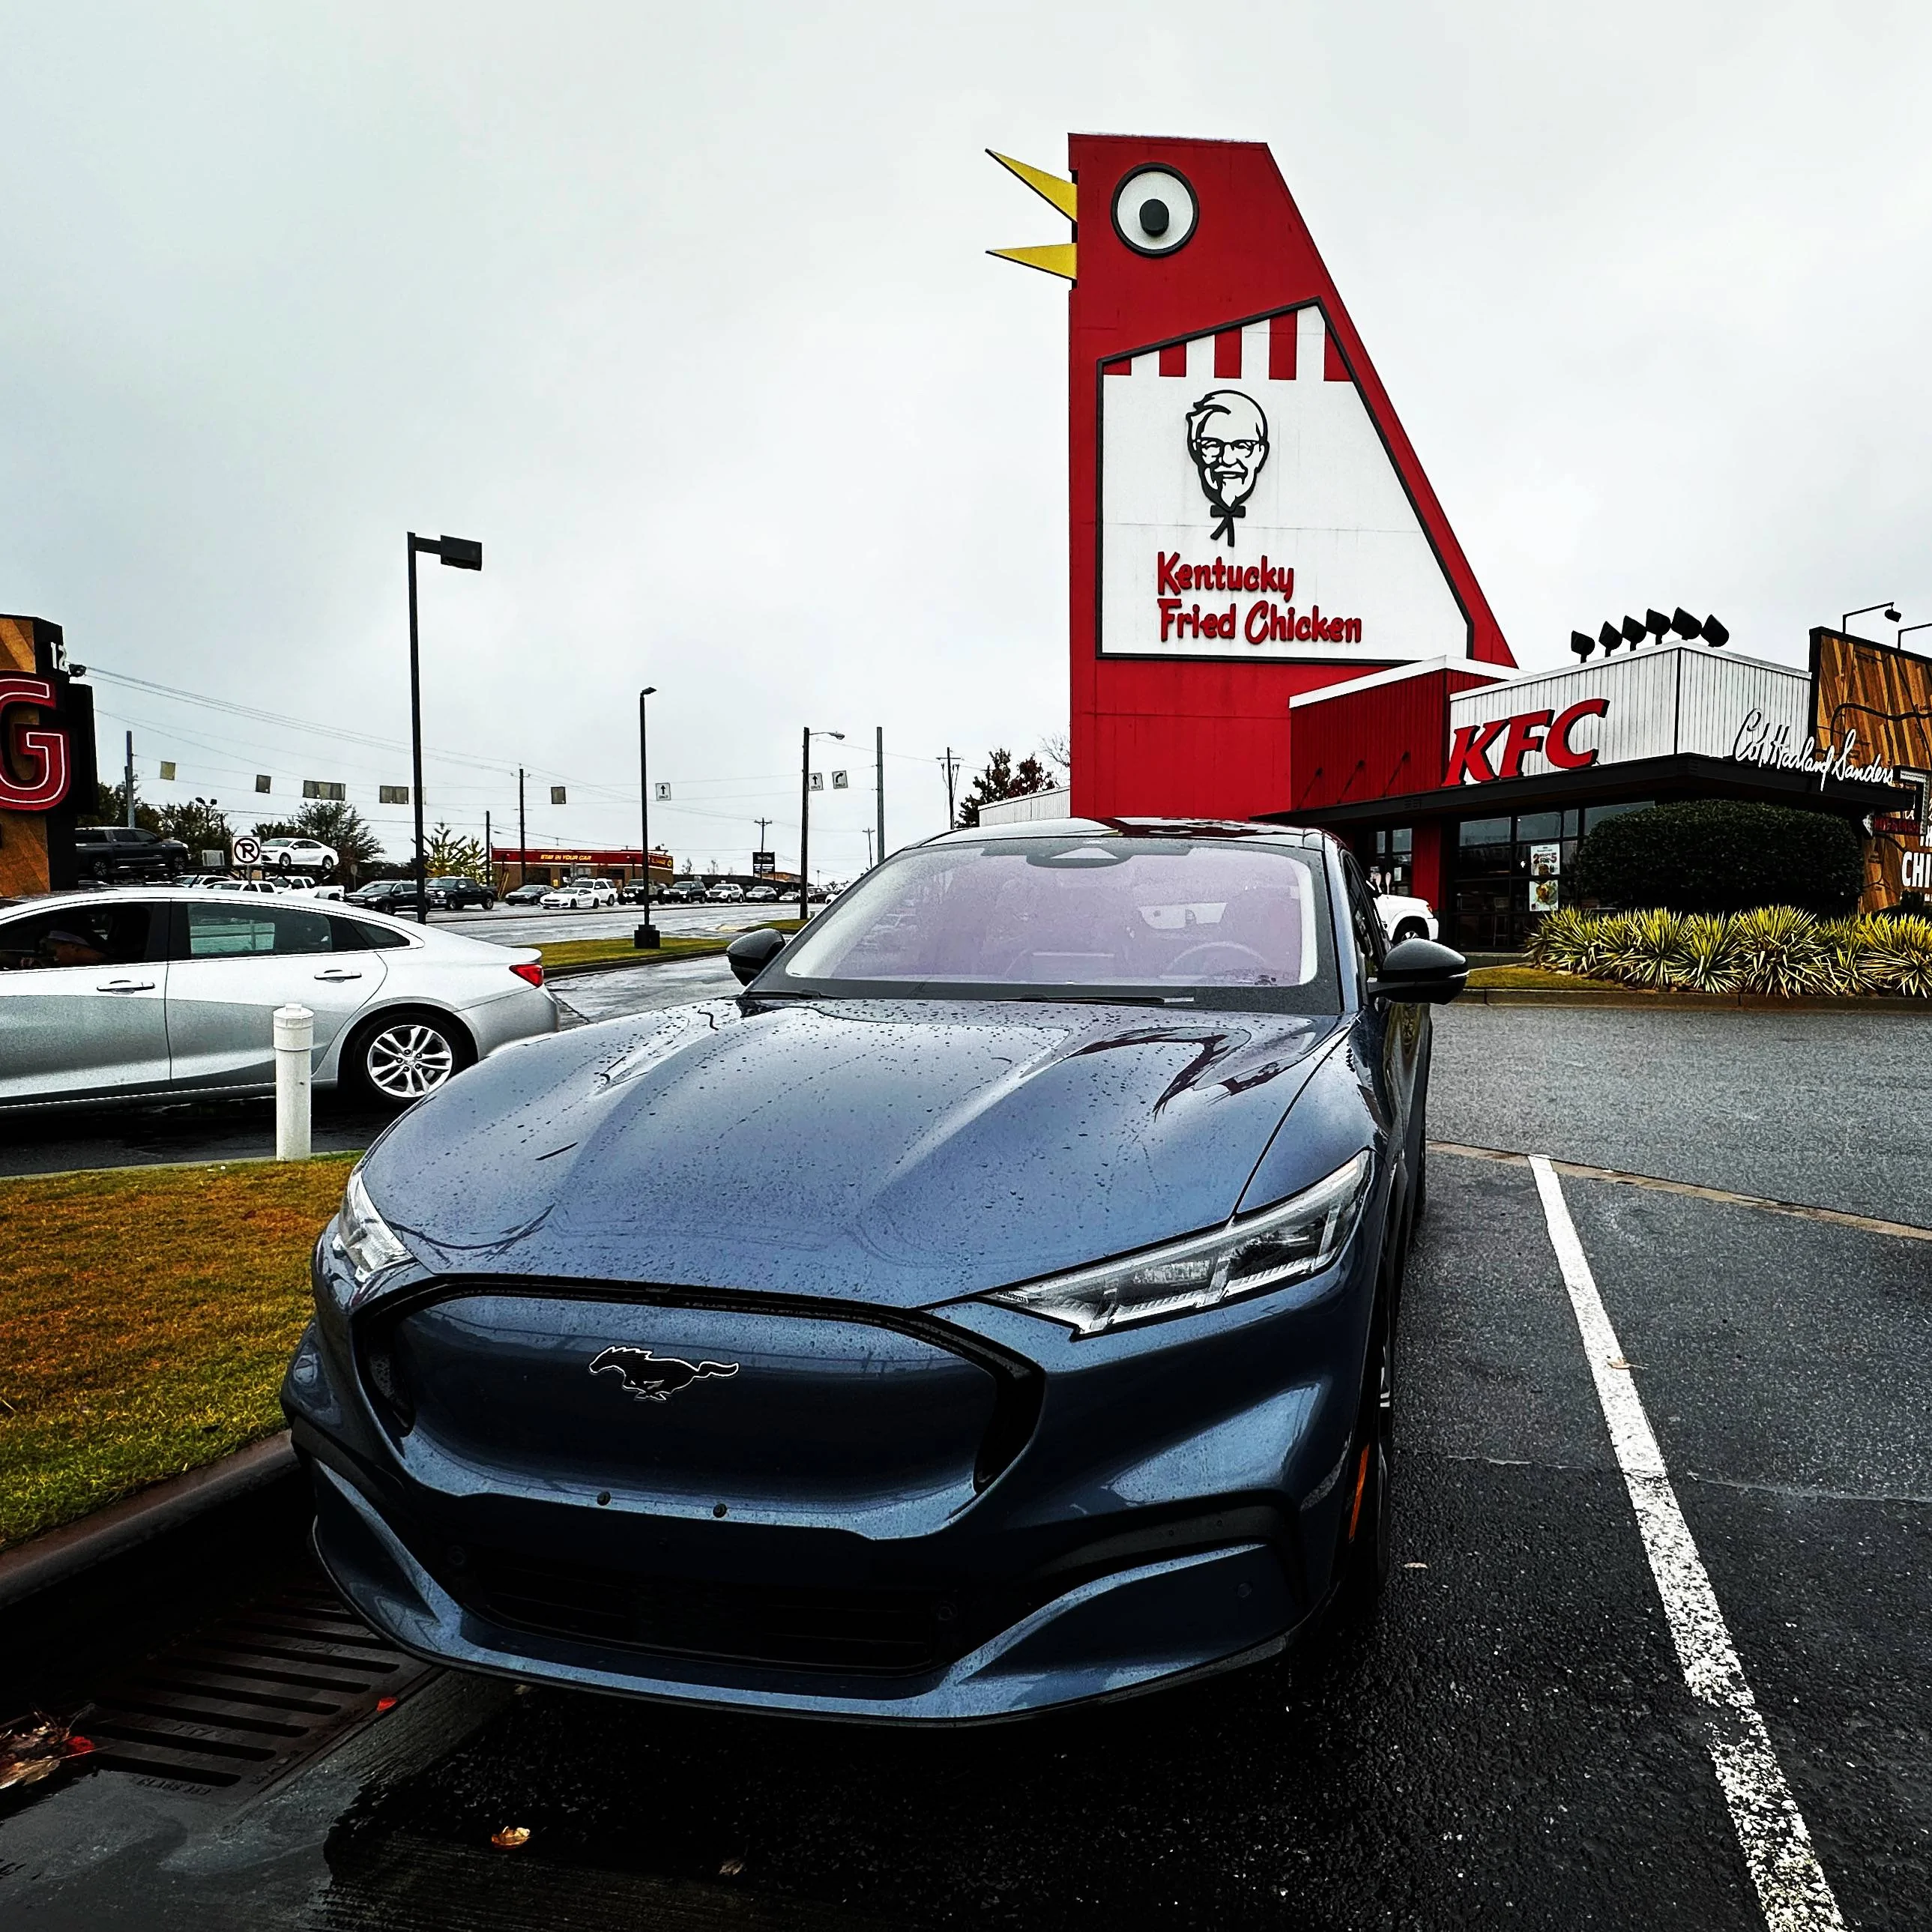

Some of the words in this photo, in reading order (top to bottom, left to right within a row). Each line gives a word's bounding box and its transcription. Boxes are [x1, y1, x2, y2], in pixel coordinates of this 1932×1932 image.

[1157, 552, 1294, 602] Kentucky
[1157, 599, 1237, 642] Fried
[1244, 600, 1362, 644] Chicken
[50, 642, 68, 672] 12
[1440, 698, 1610, 787] KFC
[1831, 728, 1894, 785] Sanders
